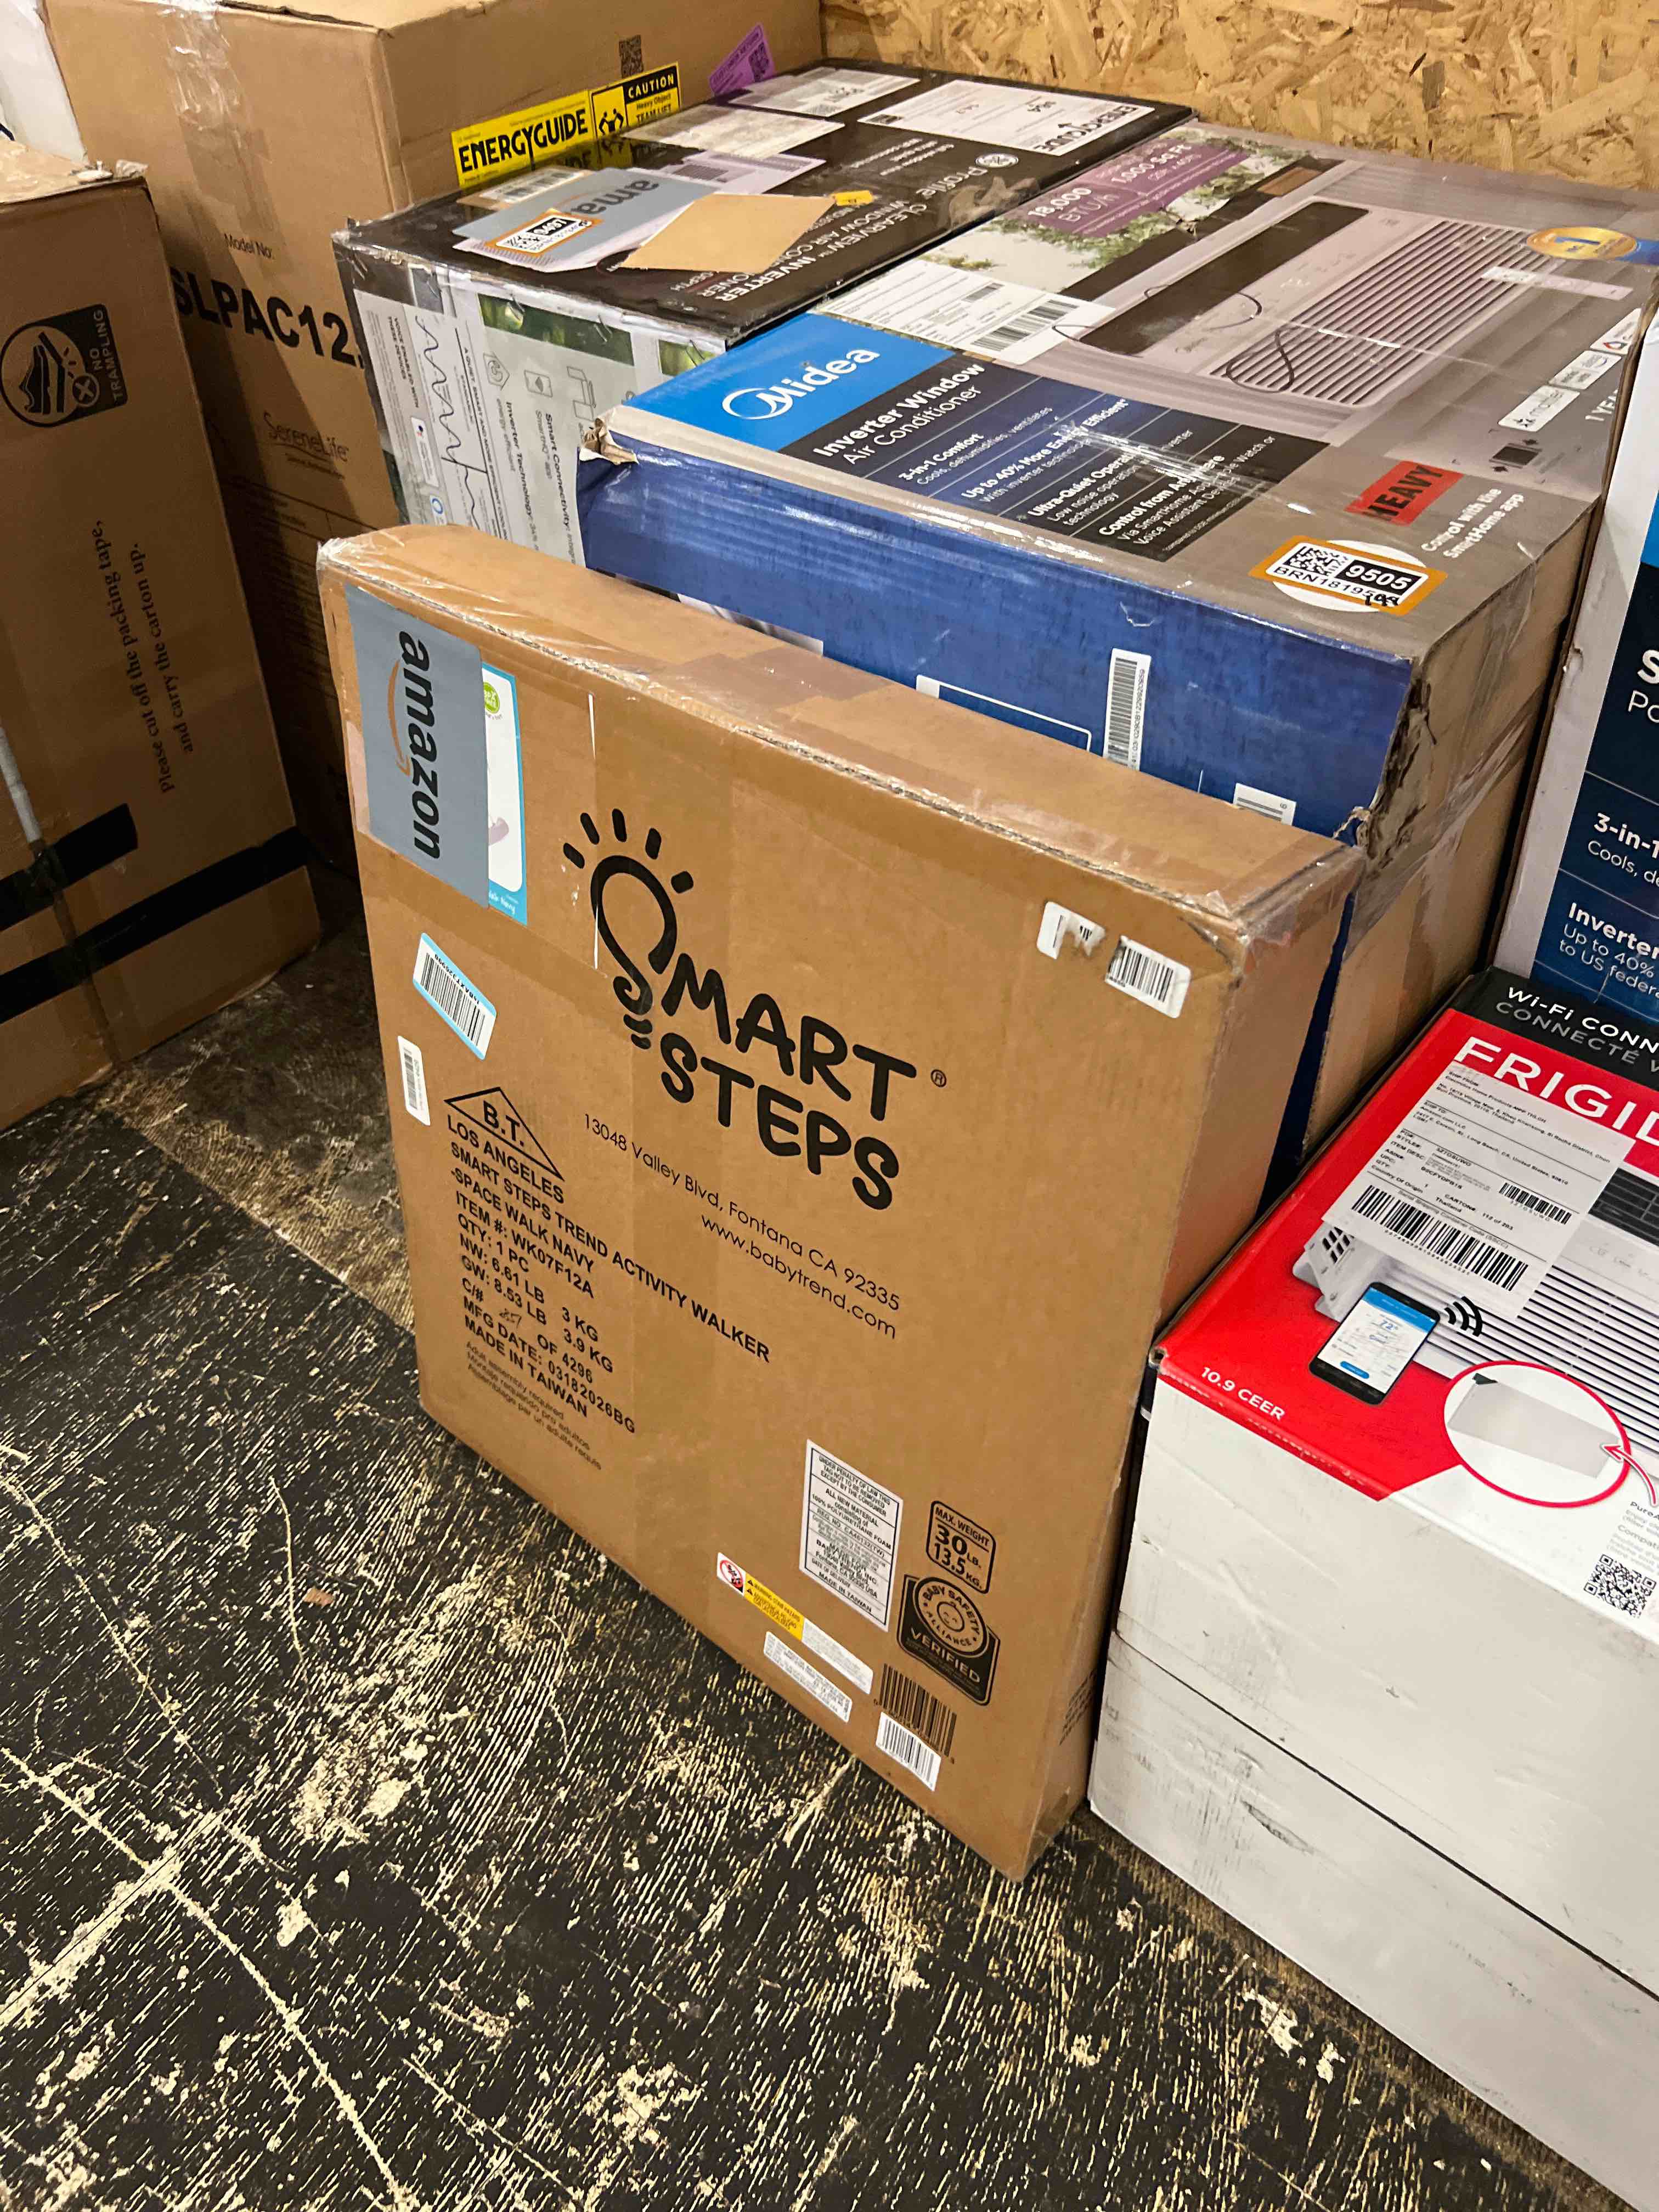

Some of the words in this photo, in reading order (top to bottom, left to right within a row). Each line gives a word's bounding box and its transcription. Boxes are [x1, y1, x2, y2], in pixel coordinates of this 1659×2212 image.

[628, 74, 675, 99] CAUTION
[653, 93, 672, 105] Object
[459, 109, 588, 173] ENERGYGUIDE
[840, 200, 911, 234] WINDOW
[1028, 187, 1092, 218] 18,000
[224, 234, 253, 254] Model
[810, 230, 839, 246] AIR
[715, 255, 817, 301] INVERTER
[89, 348, 103, 371] NO
[93, 309, 124, 402] TRAMPLING
[722, 349, 881, 419] Midea
[813, 408, 905, 457] Inverter
[897, 363, 986, 410] Window
[843, 445, 877, 466] Air
[873, 386, 983, 446] Conditioner
[505, 401, 519, 451] Inverter
[516, 452, 532, 521] Technology:
[545, 413, 557, 452] Smart
[553, 453, 571, 531] Connectivity:
[899, 459, 933, 481] 3-in-1
[932, 433, 985, 462] Comfort
[961, 484, 984, 499] Up
[979, 477, 999, 490] to
[995, 461, 1025, 481] 40%
[1018, 445, 1053, 467] More
[980, 486, 1008, 504] With
[1028, 477, 1097, 517] Ultra-Quiet
[1047, 509, 1066, 522] Low
[1071, 490, 1099, 510] noise
[1063, 492, 1121, 527] technology
[1098, 500, 1148, 536] Control
[1138, 489, 1173, 509] from
[1359, 464, 1446, 522] HEAVY
[1117, 528, 1139, 541] Via
[1133, 526, 1167, 546] Voice
[1420, 521, 1465, 552] Control
[1459, 500, 1487, 522] with
[1479, 488, 1503, 506] the
[1443, 510, 1506, 559] SmartHome
[1499, 493, 1525, 515] app
[92, 520, 112, 571] tape,
[131, 543, 146, 575] up.
[1345, 564, 1413, 590] 9505
[105, 571, 138, 647] packing
[137, 578, 162, 637] carton
[127, 650, 143, 680] the
[154, 642, 171, 672] the
[130, 682, 151, 706] off
[163, 675, 184, 718] carry
[140, 710, 160, 737] cut
[173, 722, 194, 753] and
[399, 630, 441, 860] amazon
[153, 741, 175, 794] Please
[1588, 840, 1638, 877] Cools,
[1559, 939, 1576, 957] to
[1580, 948, 1605, 971] US
[1563, 923, 1588, 946] Up
[1592, 938, 1609, 956] to
[1614, 945, 1655, 978] 40%
[1568, 902, 1659, 961] Inverter
[1508, 986, 1574, 1021] Wi-Fi
[1496, 1001, 1641, 1065] CONNECTÉ
[483, 1100, 525, 1147] B.T.
[660, 1031, 900, 1211] STEPS
[447, 1114, 479, 1147] LOS
[483, 1142, 566, 1204] ANGELES
[583, 1113, 628, 1152] 13048
[631, 1141, 681, 1186] Valley
[684, 1175, 724, 1213] Blvd,
[729, 1201, 803, 1257] Fontana
[808, 1248, 839, 1278] CA
[843, 1267, 900, 1312] 92335
[450, 1141, 500, 1186] SMART
[503, 1181, 552, 1221] STEPS
[554, 1211, 608, 1258] TREND
[612, 1251, 687, 1309] ACTIVITY
[691, 1299, 771, 1363] WALKER
[456, 1190, 492, 1226] ITEM
[494, 1217, 508, 1237] #:
[511, 1227, 595, 1299] WK07F12A
[458, 1212, 493, 1248] QTY:
[495, 1240, 504, 1256] 1
[507, 1246, 529, 1273] PC
[505, 1200, 549, 1245] WALK
[552, 1233, 595, 1274] NAVY
[459, 1232, 488, 1265] NW:
[491, 1257, 520, 1286] 6.61
[523, 1278, 545, 1305] LB
[561, 1306, 572, 1324] 3
[573, 1315, 599, 1343] KG
[700, 1215, 897, 1340] www.babytrend.com
[460, 1254, 490, 1286] GW:
[493, 1278, 523, 1308] 8.53
[526, 1300, 548, 1326] LB
[562, 1329, 585, 1354] 3.9
[589, 1345, 614, 1374] KG
[461, 1277, 484, 1304] C/#
[537, 1333, 558, 1356] OF
[561, 1353, 594, 1385] 4296
[463, 1295, 494, 1330] MFG
[497, 1321, 544, 1367] DATE:
[547, 1359, 636, 1435] 03182026BG
[464, 1314, 506, 1358] MADE
[508, 1348, 524, 1372] IN
[526, 1359, 589, 1419] TAIWAN
[1201, 1366, 1235, 1392] 10.9
[1237, 1388, 1285, 1421] CEER
[820, 1470, 840, 1486] EXCEPT
[839, 1482, 849, 1492] BY
[848, 1487, 859, 1498] THE
[833, 1471, 845, 1482] NOT
[845, 1477, 853, 1486] TO
[852, 1482, 860, 1491] BE
[859, 1486, 885, 1509] REMOVED
[836, 1465, 859, 1483] PENALTY
[859, 1479, 867, 1488] OF
[867, 1483, 879, 1496] LAW
[825, 1487, 837, 1499] ALL
[837, 1494, 851, 1508] NEW
[850, 1503, 879, 1527] MATERIAL
[861, 1518, 869, 1529] of
[935, 1506, 956, 1528] MAX.
[957, 1521, 990, 1548] WEIGHT
[873, 1533, 892, 1550] FOAM
[935, 1523, 968, 1555] 30
[966, 1551, 983, 1570] LB.
[934, 1543, 966, 1576] 13.5
[965, 1572, 983, 1589] KG.
[922, 1584, 945, 1603] BABY
[947, 1590, 981, 1638] SAFETY
[925, 1609, 973, 1647] ALLIANCE
[909, 1627, 981, 1684] VERIFIED
